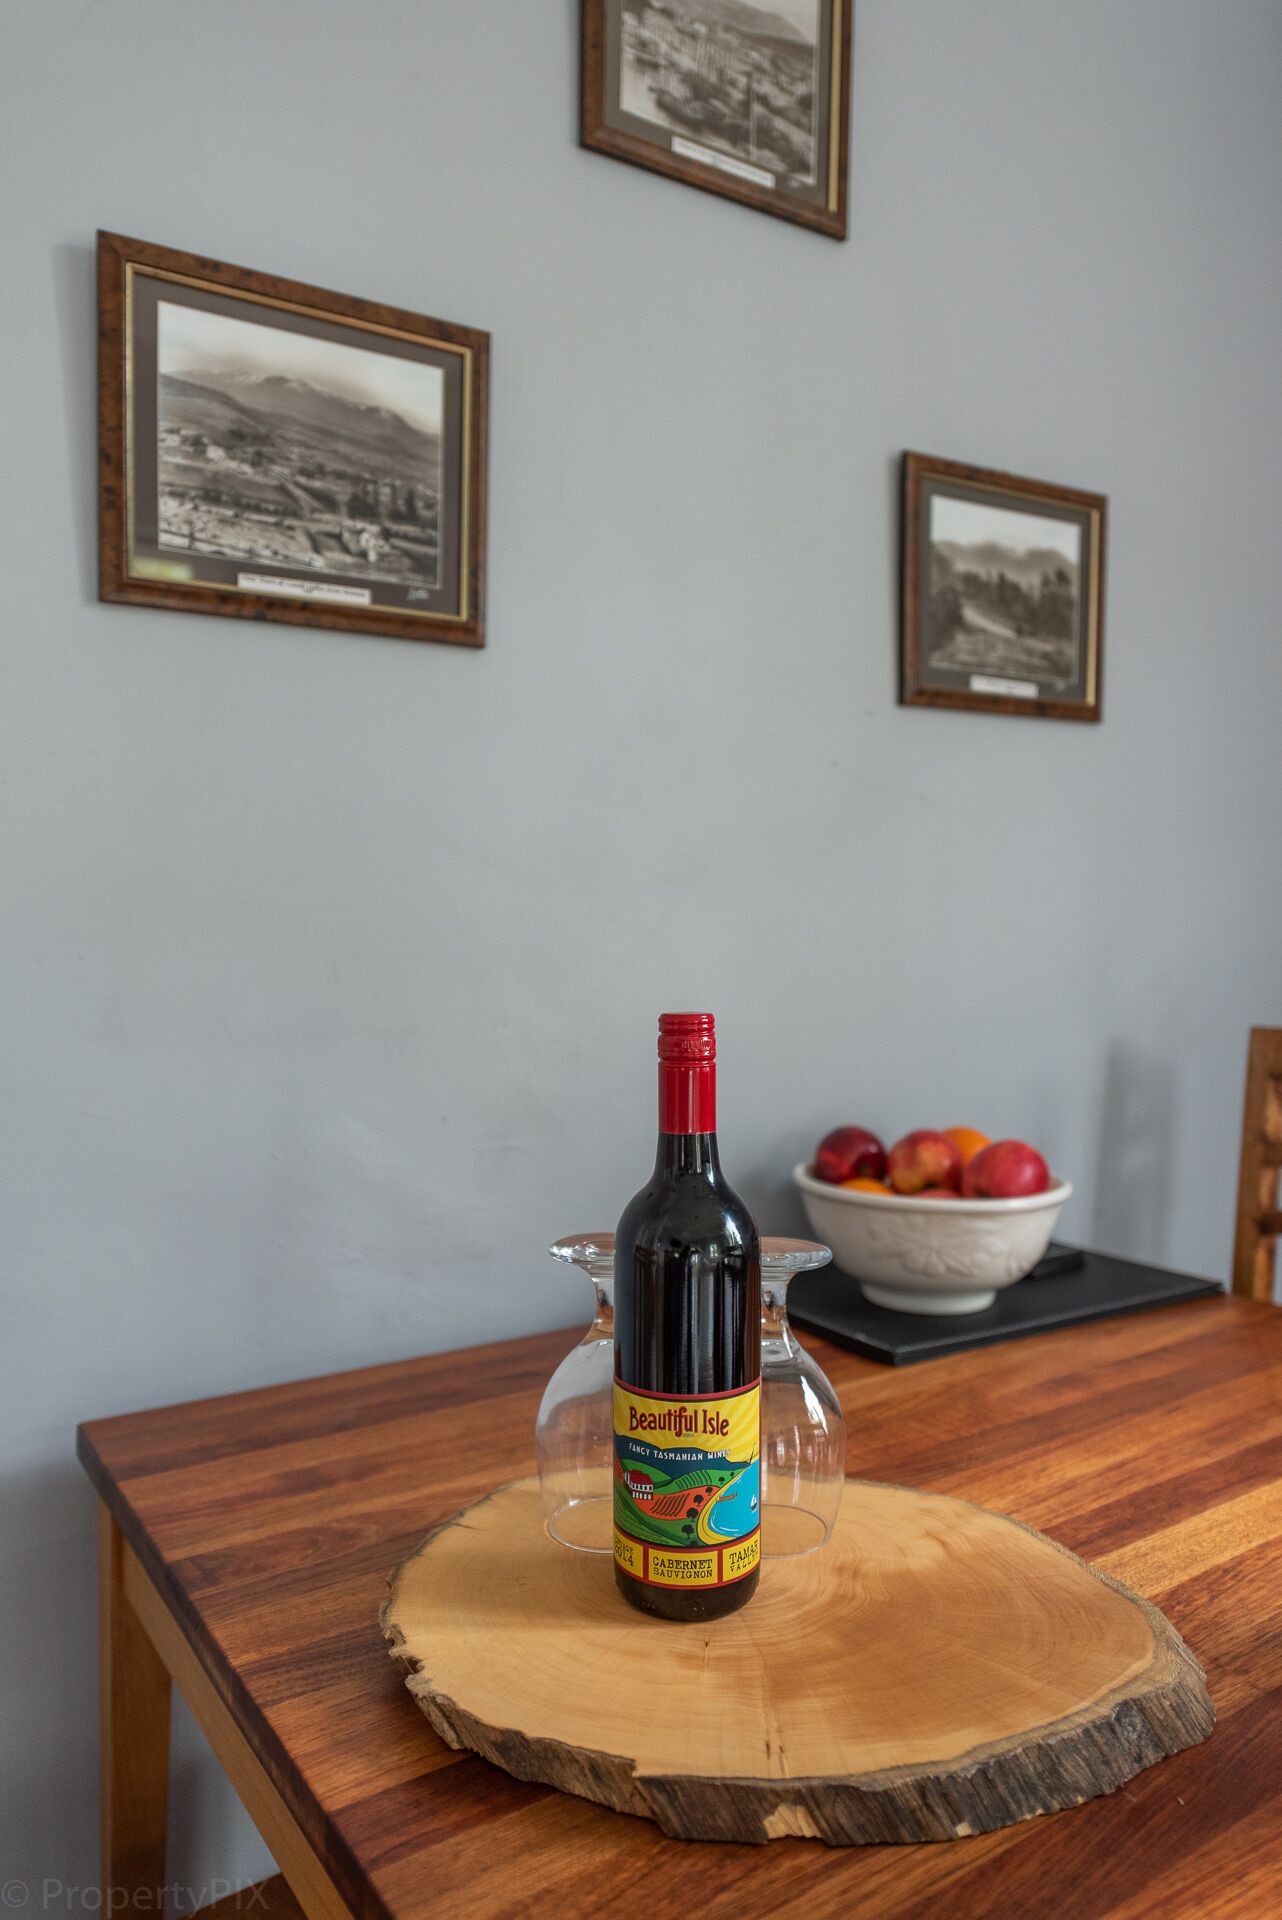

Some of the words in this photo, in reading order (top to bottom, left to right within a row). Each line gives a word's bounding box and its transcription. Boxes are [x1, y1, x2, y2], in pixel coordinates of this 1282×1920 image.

[628, 1406, 698, 1438] Beautiful
[702, 1409, 730, 1437] Isle
[628, 1442, 650, 1457] FANCY
[654, 1449, 704, 1461] TASMANIAN
[707, 1449, 731, 1460] WINES
[652, 1556, 713, 1570] CABERNET
[728, 1540, 759, 1565] TAMAR
[729, 1550, 759, 1573] VALLEY
[652, 1567, 713, 1579] SAUVIGNON
